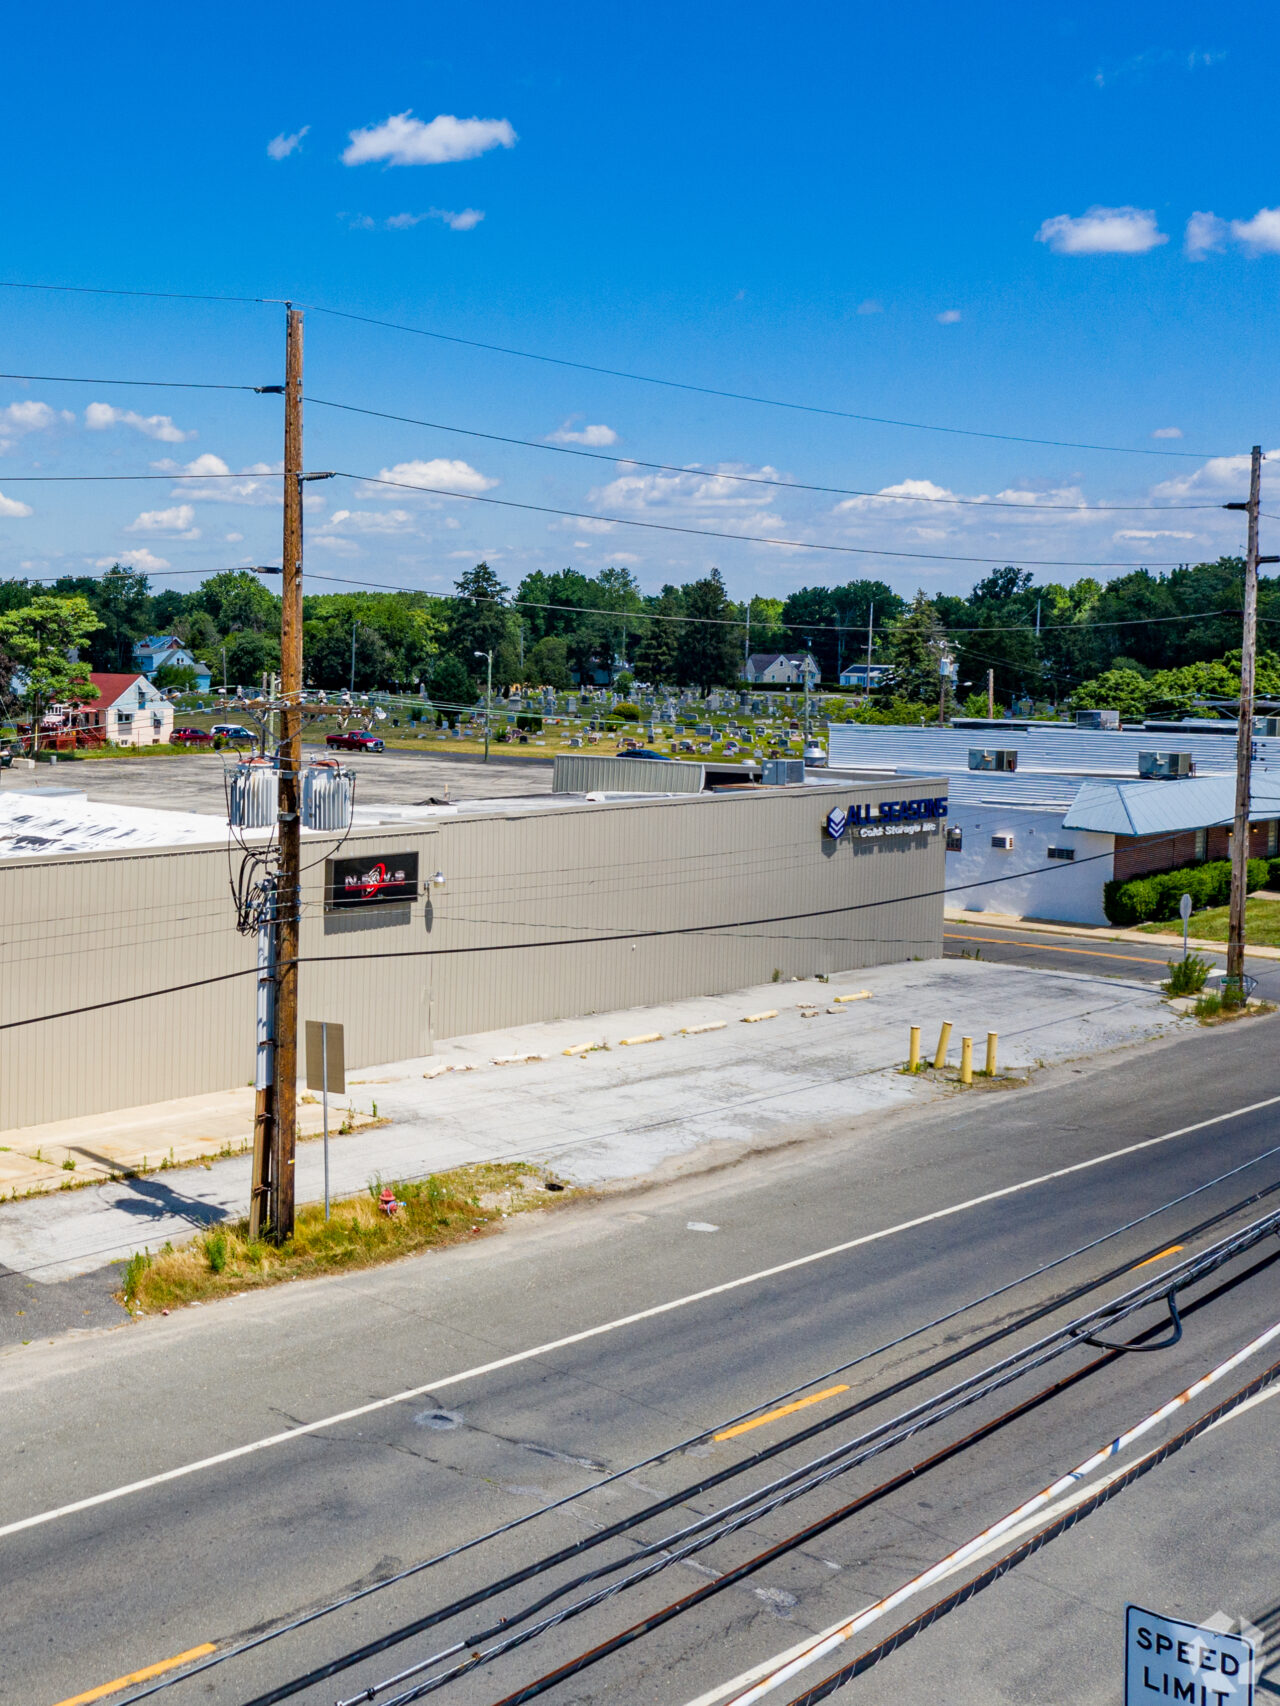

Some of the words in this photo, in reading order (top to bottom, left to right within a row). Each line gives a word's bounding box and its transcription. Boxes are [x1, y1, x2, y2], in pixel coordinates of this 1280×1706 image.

[846, 804, 877, 826] ALL
[879, 797, 948, 823] SEASONS
[885, 824, 921, 835] Storage
[1136, 1627, 1240, 1676] SPEED
[1144, 1665, 1230, 1706] LIMIT
